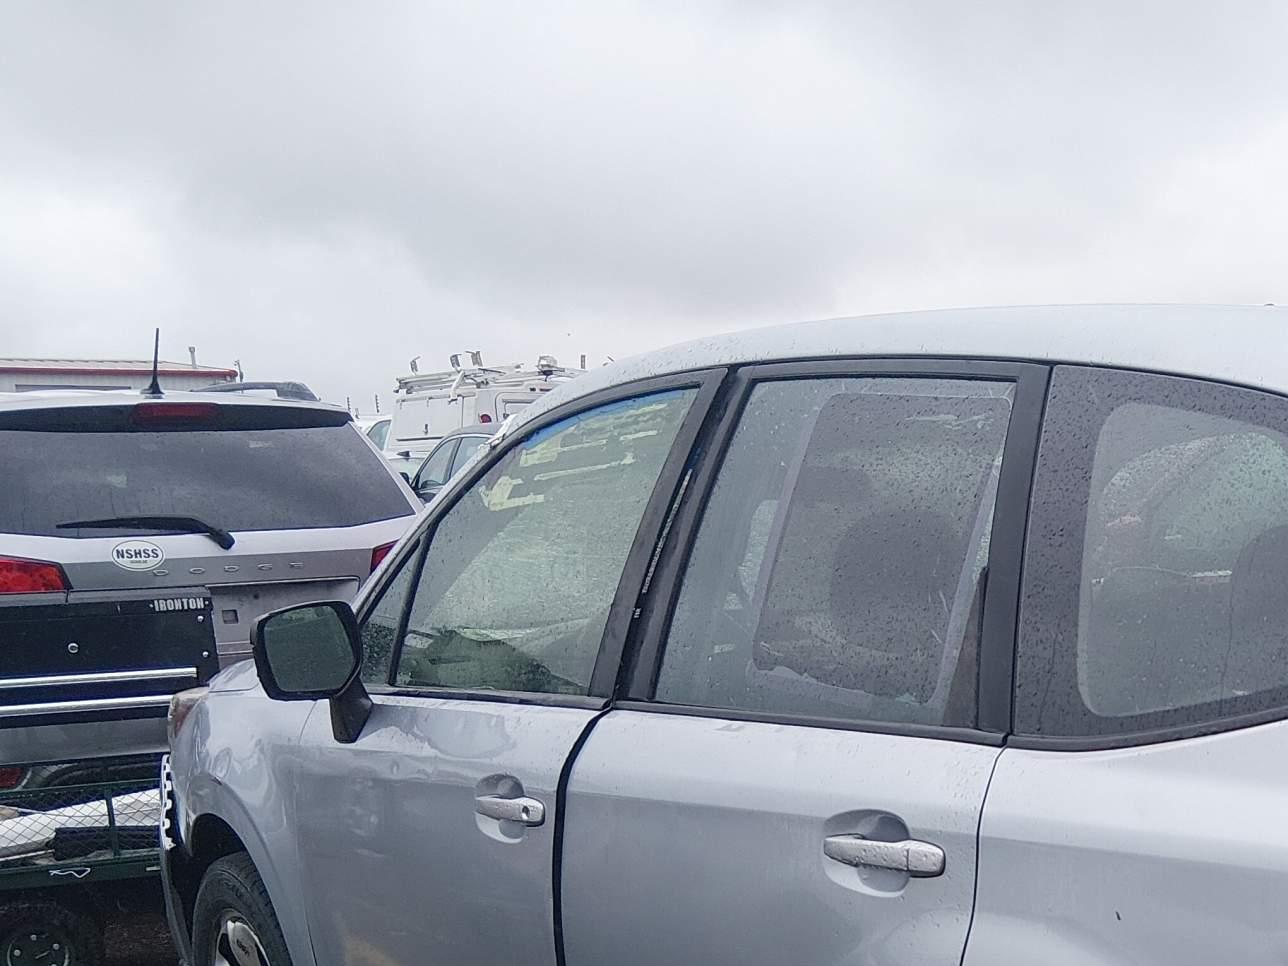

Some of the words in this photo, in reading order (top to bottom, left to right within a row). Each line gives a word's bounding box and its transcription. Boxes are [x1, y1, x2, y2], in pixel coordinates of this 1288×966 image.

[115, 547, 160, 560] NSHSS
[152, 561, 305, 577] DODGE
[153, 596, 205, 612] IRONTON
